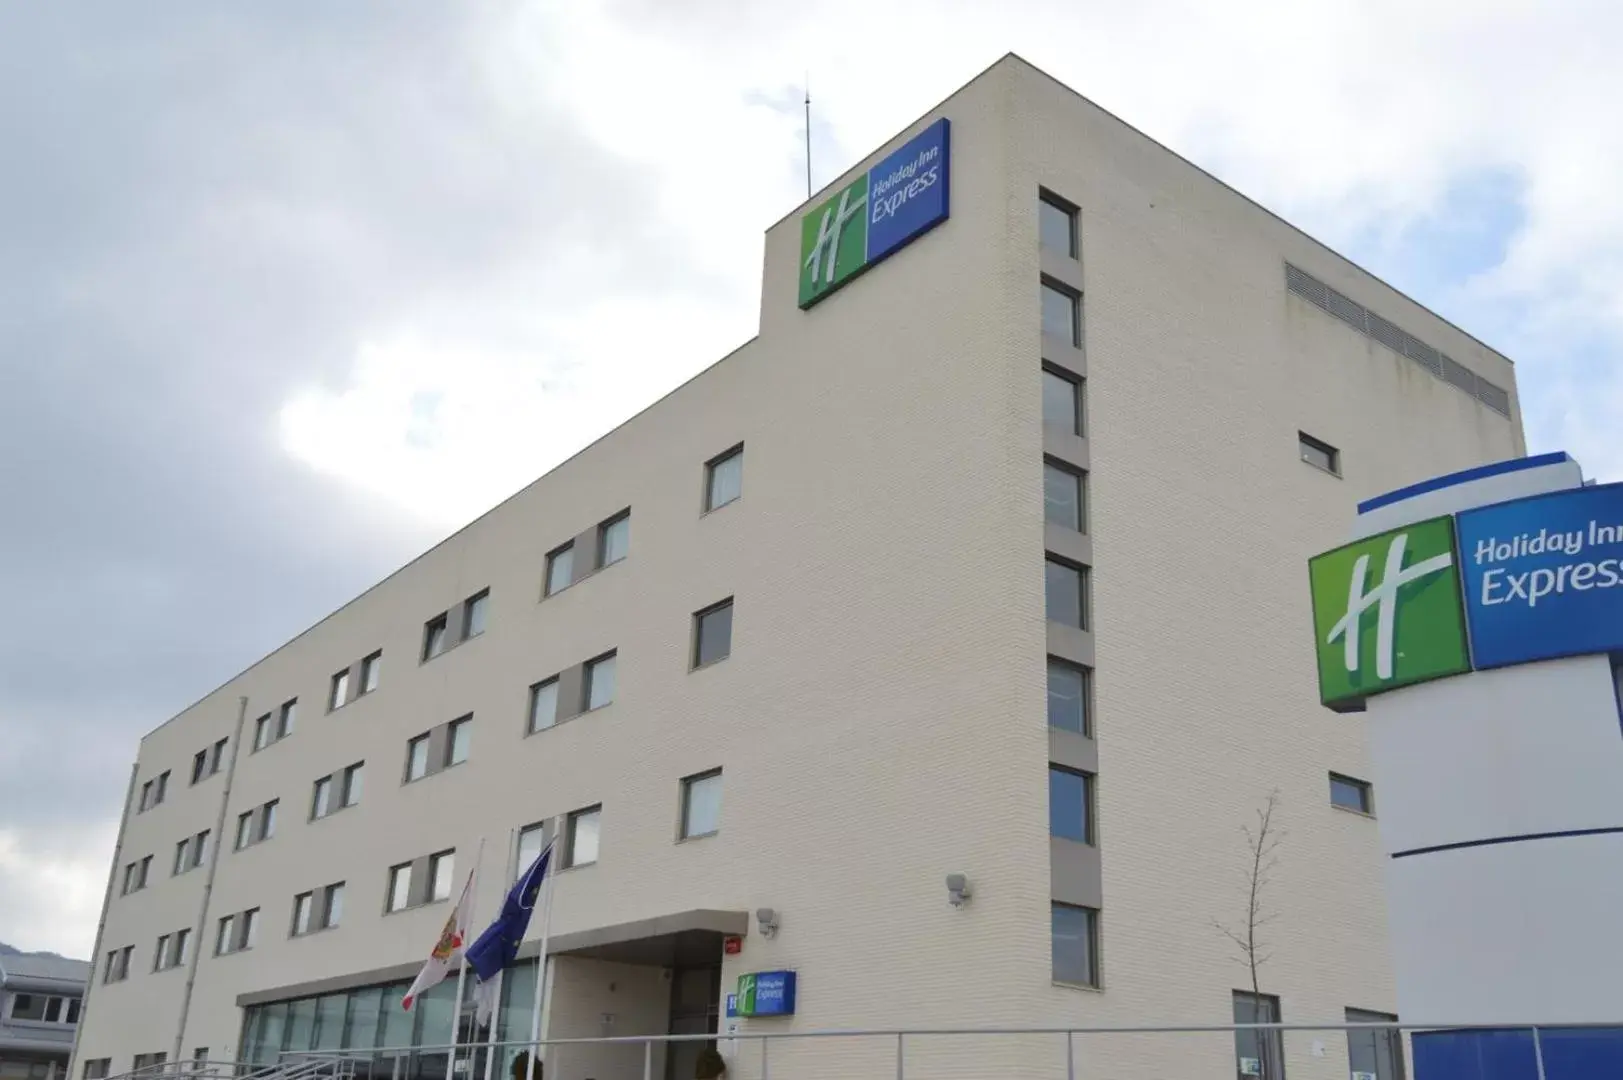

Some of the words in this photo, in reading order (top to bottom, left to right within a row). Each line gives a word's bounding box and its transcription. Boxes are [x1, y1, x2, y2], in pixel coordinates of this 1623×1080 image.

[871, 162, 917, 200] Holiday
[917, 146, 938, 168] Inn
[872, 166, 938, 224] Express
[1474, 528, 1583, 565] Holiday
[1481, 558, 1623, 607] Expres
